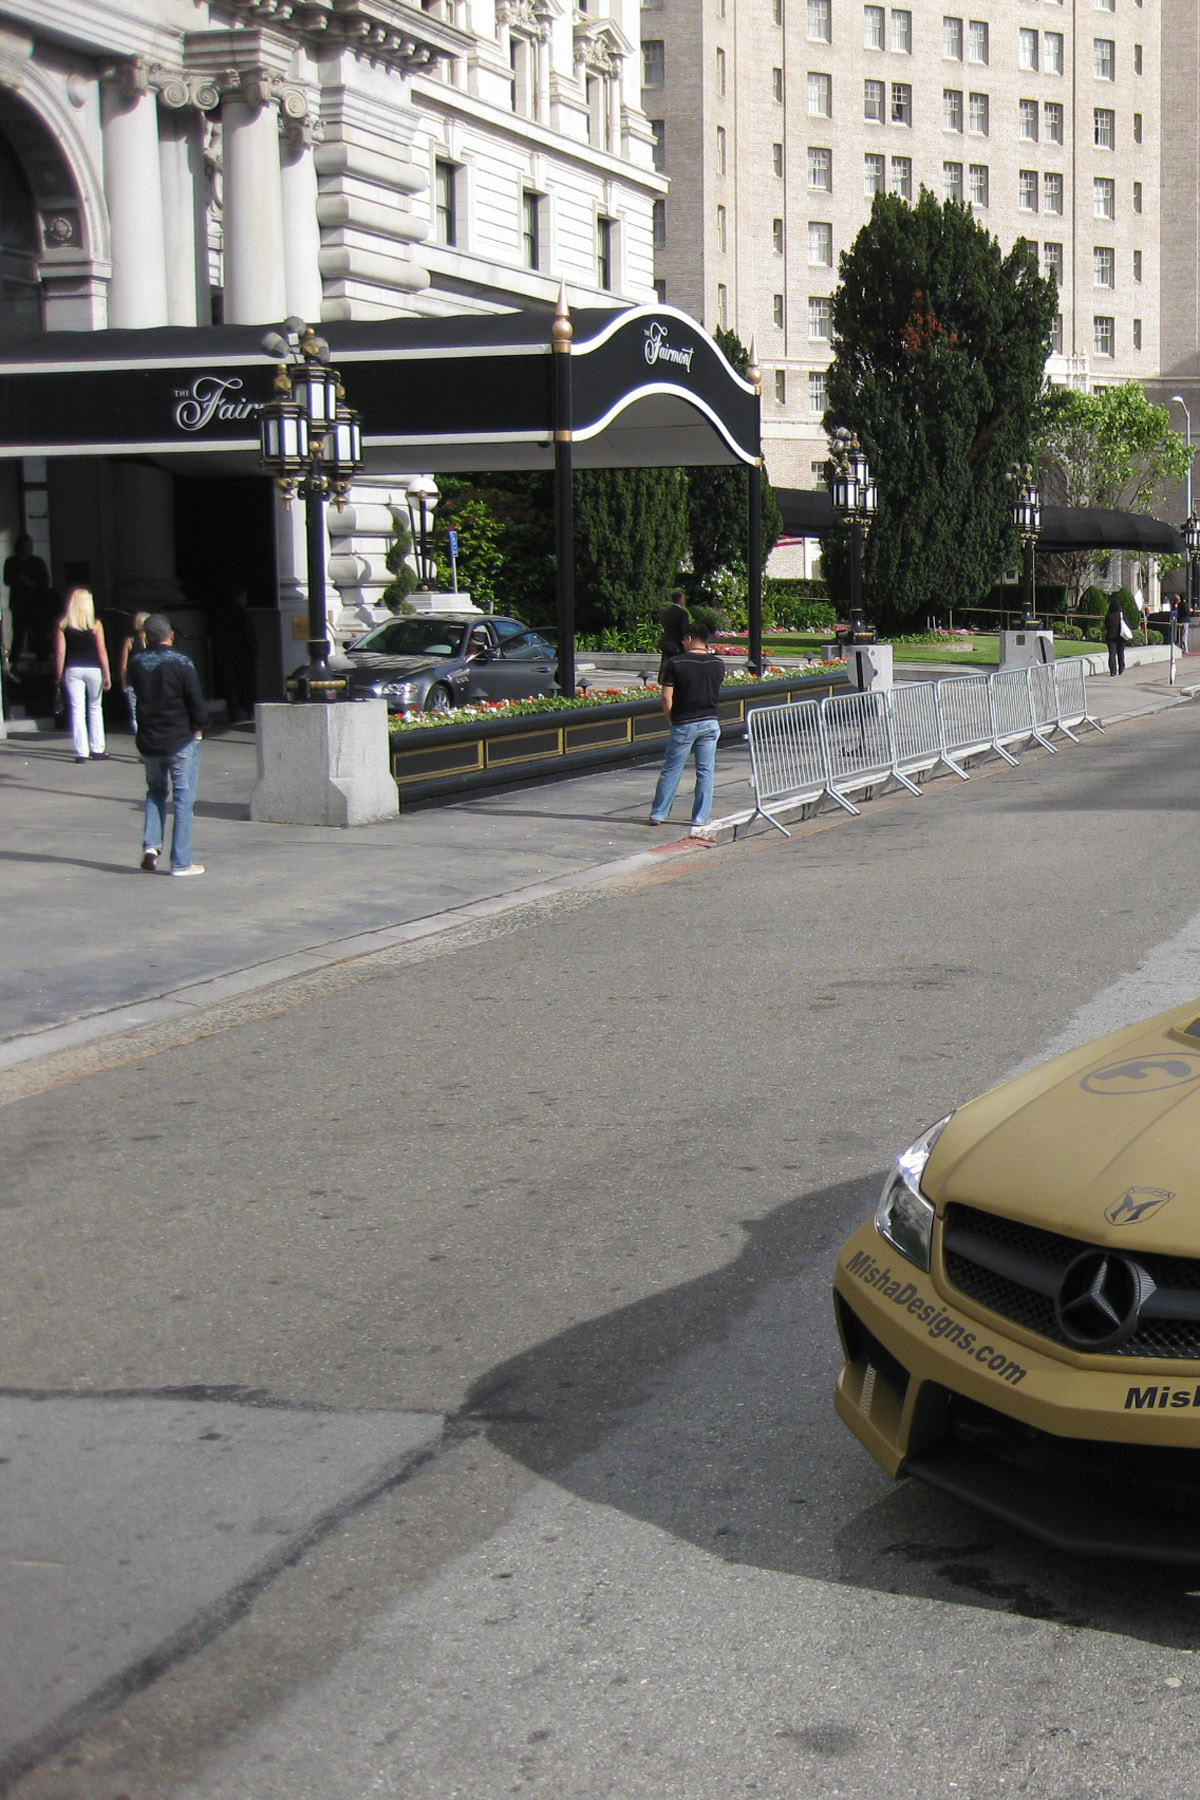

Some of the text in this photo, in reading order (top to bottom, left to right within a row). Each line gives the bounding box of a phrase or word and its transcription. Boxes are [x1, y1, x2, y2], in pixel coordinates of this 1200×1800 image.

[644, 322, 695, 373] Fairmont
[176, 376, 264, 431] Fair
[845, 1250, 1028, 1385] MishaDesigns.com
